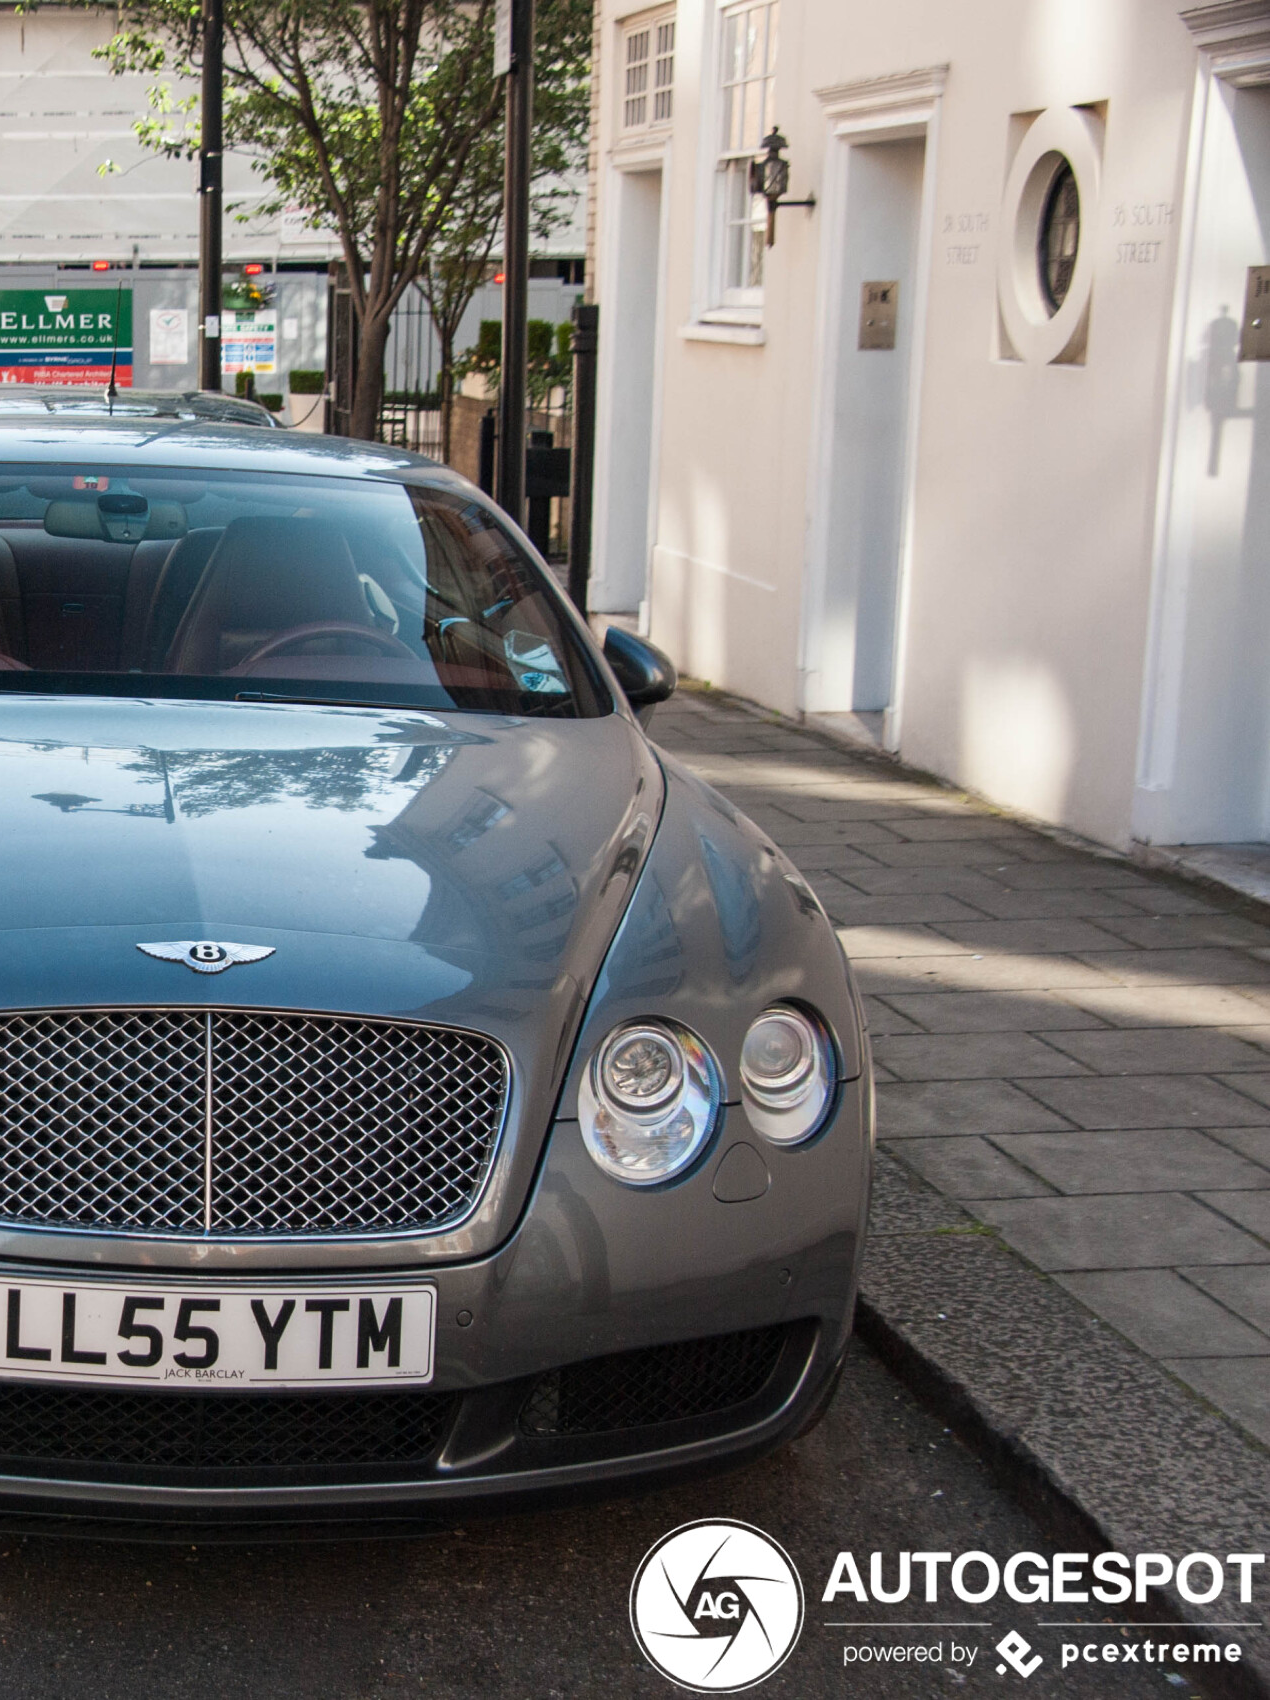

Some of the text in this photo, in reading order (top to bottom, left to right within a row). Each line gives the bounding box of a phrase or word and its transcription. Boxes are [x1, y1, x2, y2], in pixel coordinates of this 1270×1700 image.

[1132, 202, 1174, 225] SOUTH
[1116, 241, 1161, 263] STREET
[0, 312, 112, 330] ELLMER
[0, 334, 113, 344] www.ellmers.co.uk
[6, 1288, 403, 1370] LL55 YTM
[164, 1368, 246, 1380] JACK BARCLAY
